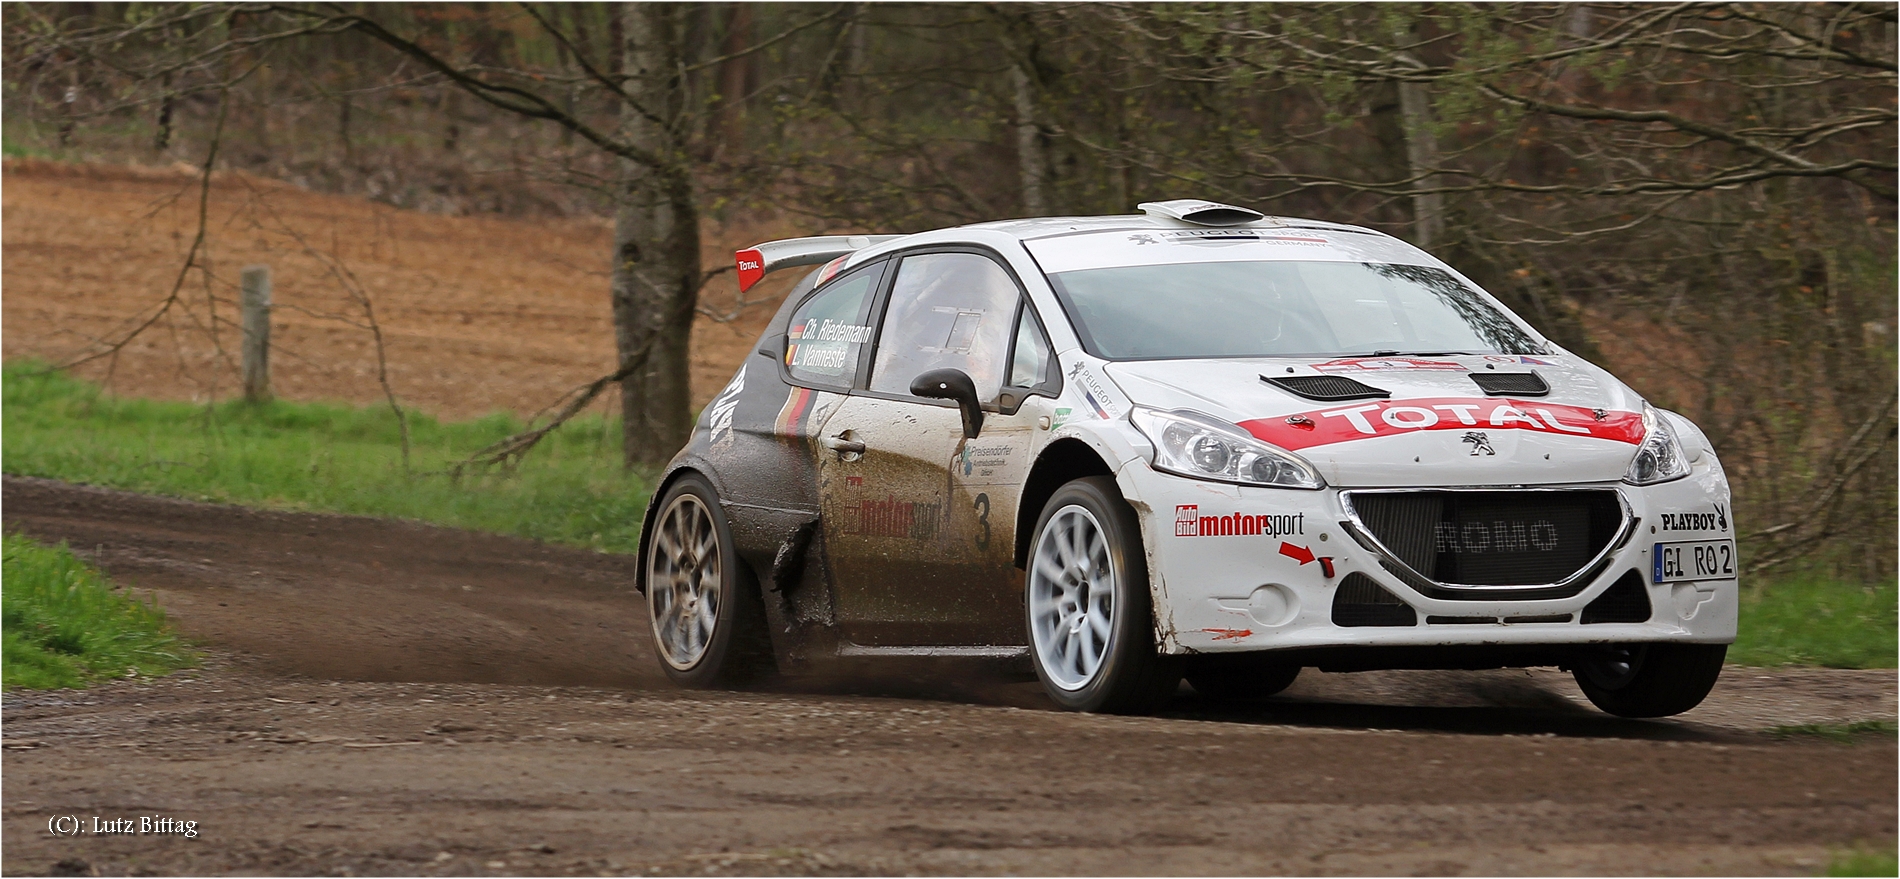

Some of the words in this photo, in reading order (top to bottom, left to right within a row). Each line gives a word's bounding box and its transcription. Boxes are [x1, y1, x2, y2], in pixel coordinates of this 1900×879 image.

[1265, 240, 1327, 248] GERMANY
[802, 318, 817, 340] Ch.
[818, 319, 872, 344] Riedemann
[791, 344, 800, 366] L.
[802, 345, 846, 368] Vanneste
[1082, 369, 1113, 407] PEUGEOT
[1322, 403, 1593, 435] TOTAL
[973, 492, 991, 551] 3
[1176, 506, 1197, 521] Auto
[1661, 513, 1716, 530] PLAYBOY
[1176, 521, 1197, 535] Bild
[1434, 520, 1558, 553] ROMO
[1664, 547, 1684, 577] GI
